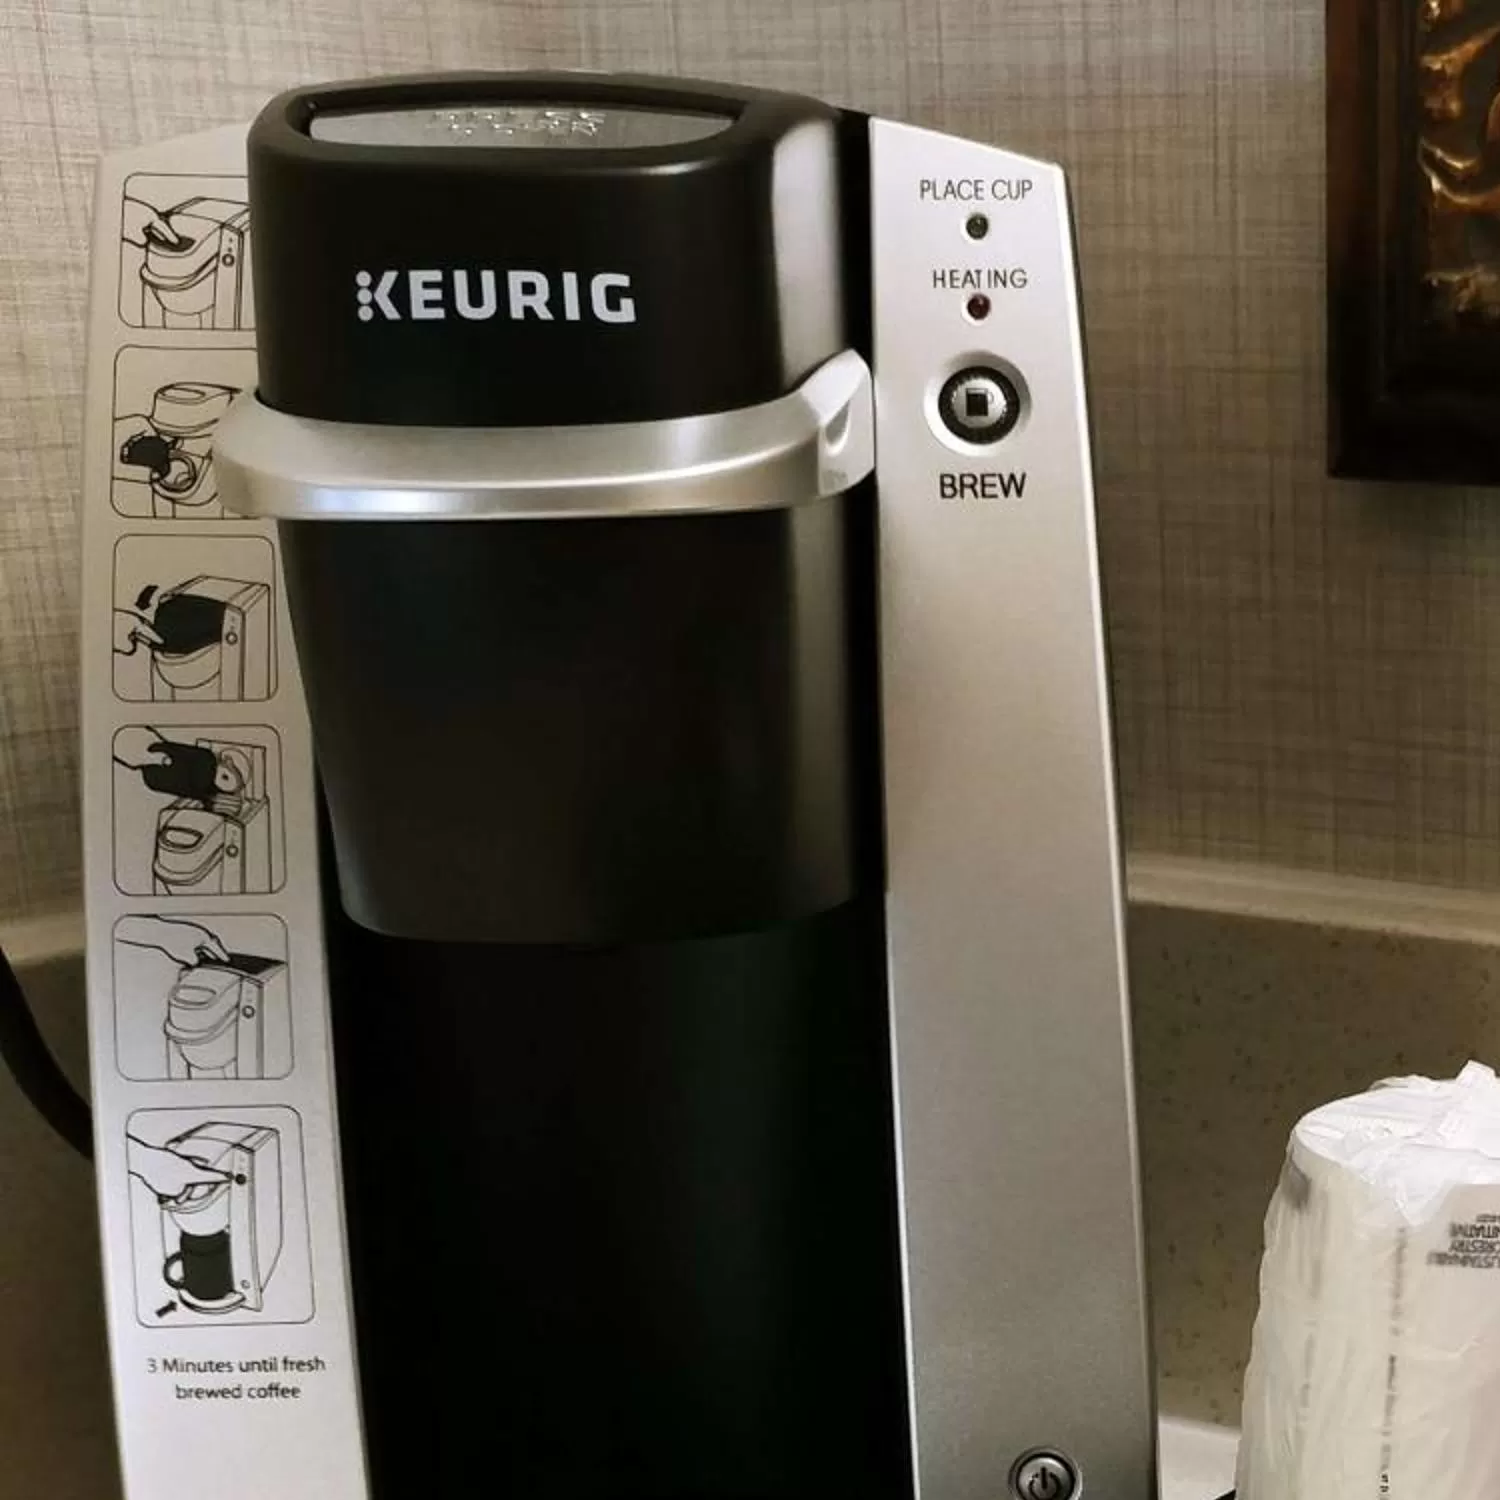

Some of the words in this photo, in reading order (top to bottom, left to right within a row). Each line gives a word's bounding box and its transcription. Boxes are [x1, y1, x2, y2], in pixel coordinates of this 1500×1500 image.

[919, 179, 985, 200] PLACE
[991, 179, 1034, 200] CUP
[932, 268, 1028, 289] HEATING
[356, 269, 637, 323] KEURIG
[939, 472, 1027, 500] BREW
[146, 1357, 157, 1374] 3
[162, 1357, 234, 1373] Minutes
[239, 1356, 278, 1373] until
[283, 1355, 326, 1372] fresh
[175, 1383, 243, 1400] brewed
[247, 1383, 301, 1399] coffee
